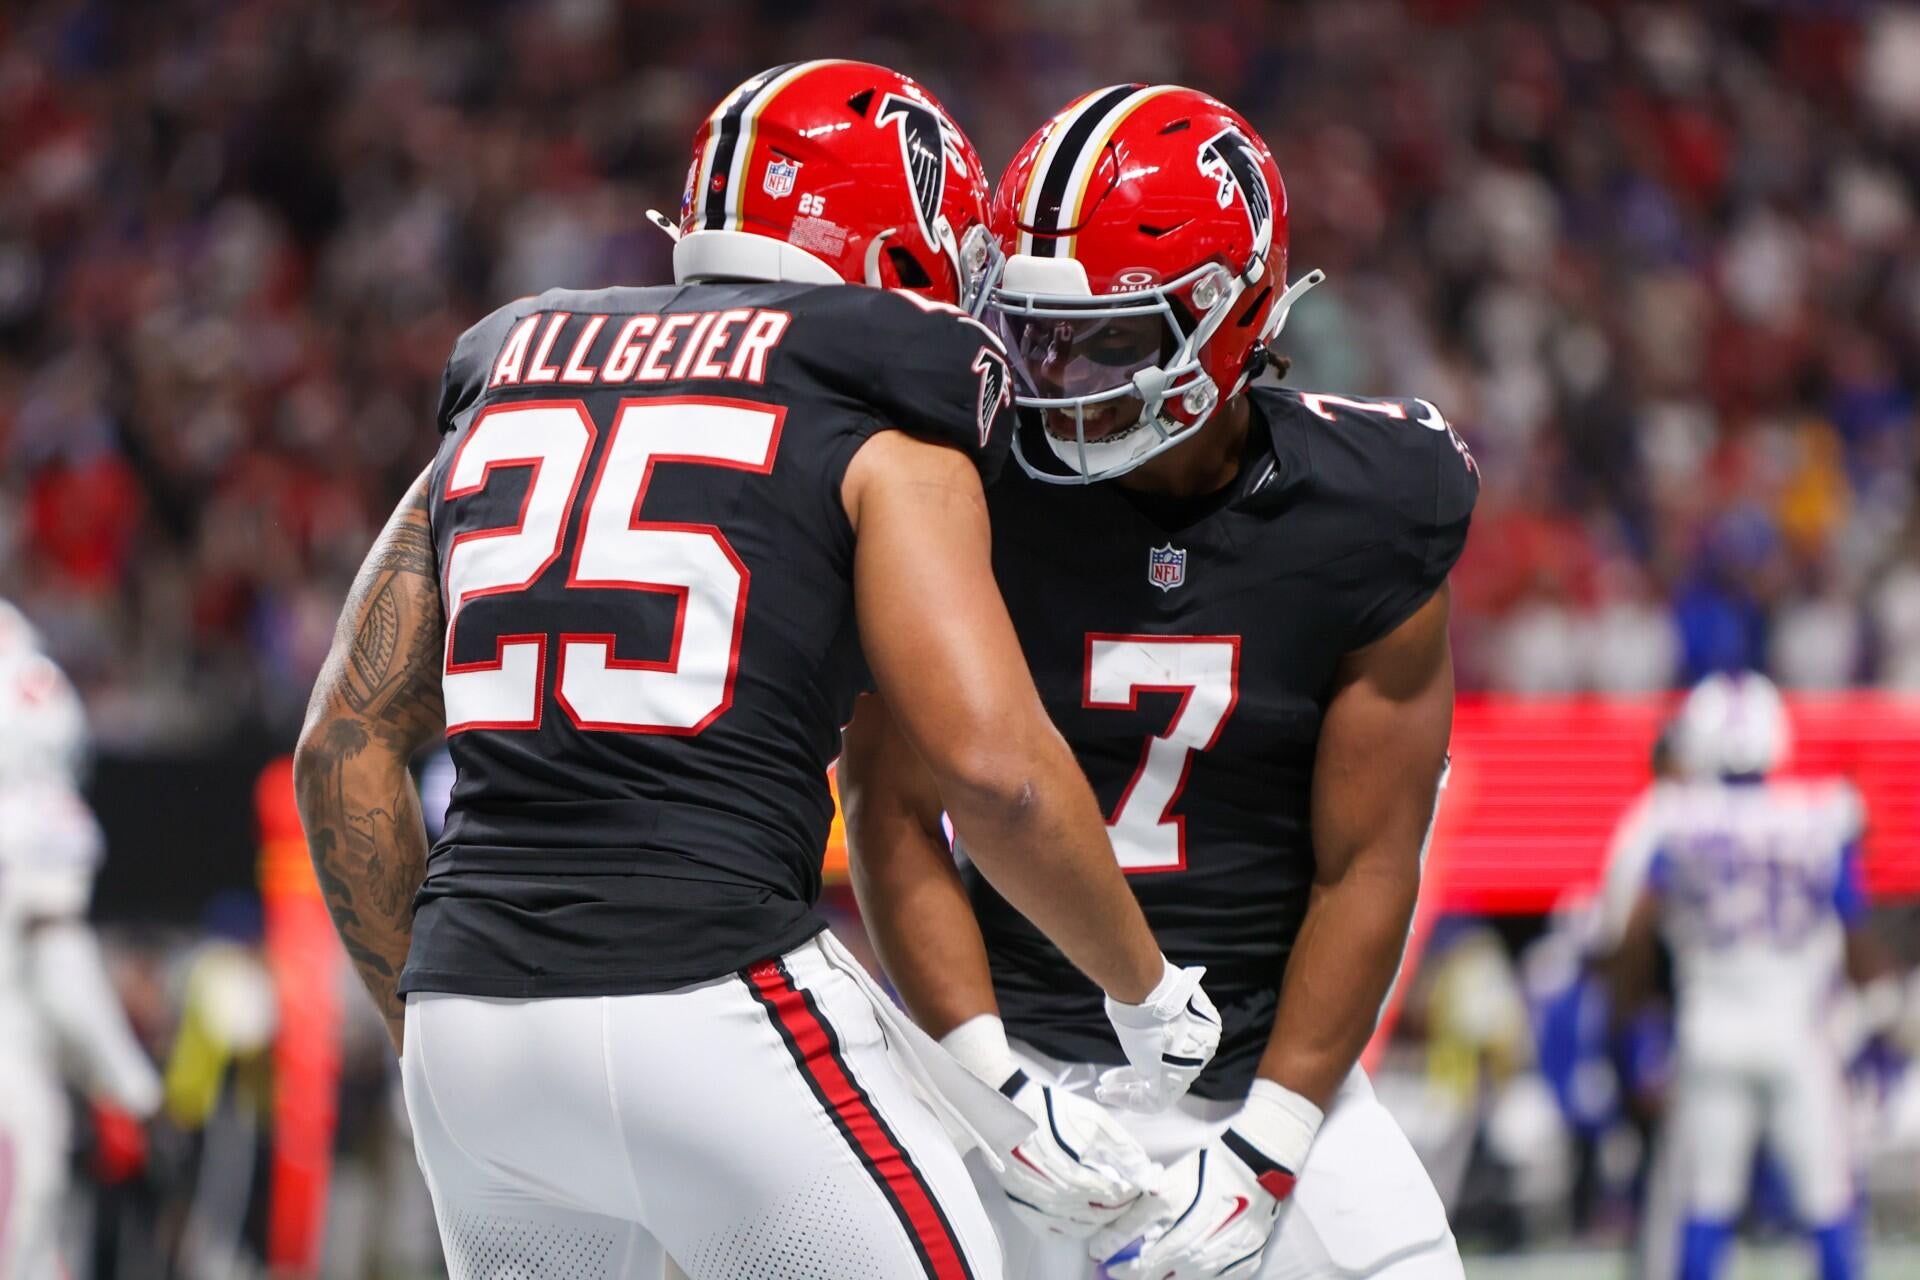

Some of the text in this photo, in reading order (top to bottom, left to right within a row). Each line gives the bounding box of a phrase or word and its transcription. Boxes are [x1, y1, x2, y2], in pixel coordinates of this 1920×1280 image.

[768, 174, 790, 192] NFL
[798, 192, 826, 217] 25
[489, 308, 793, 389] ALLGEIER
[442, 395, 788, 737] 25
[1154, 564, 1179, 582] NFL
[1082, 632, 1242, 874] 7
